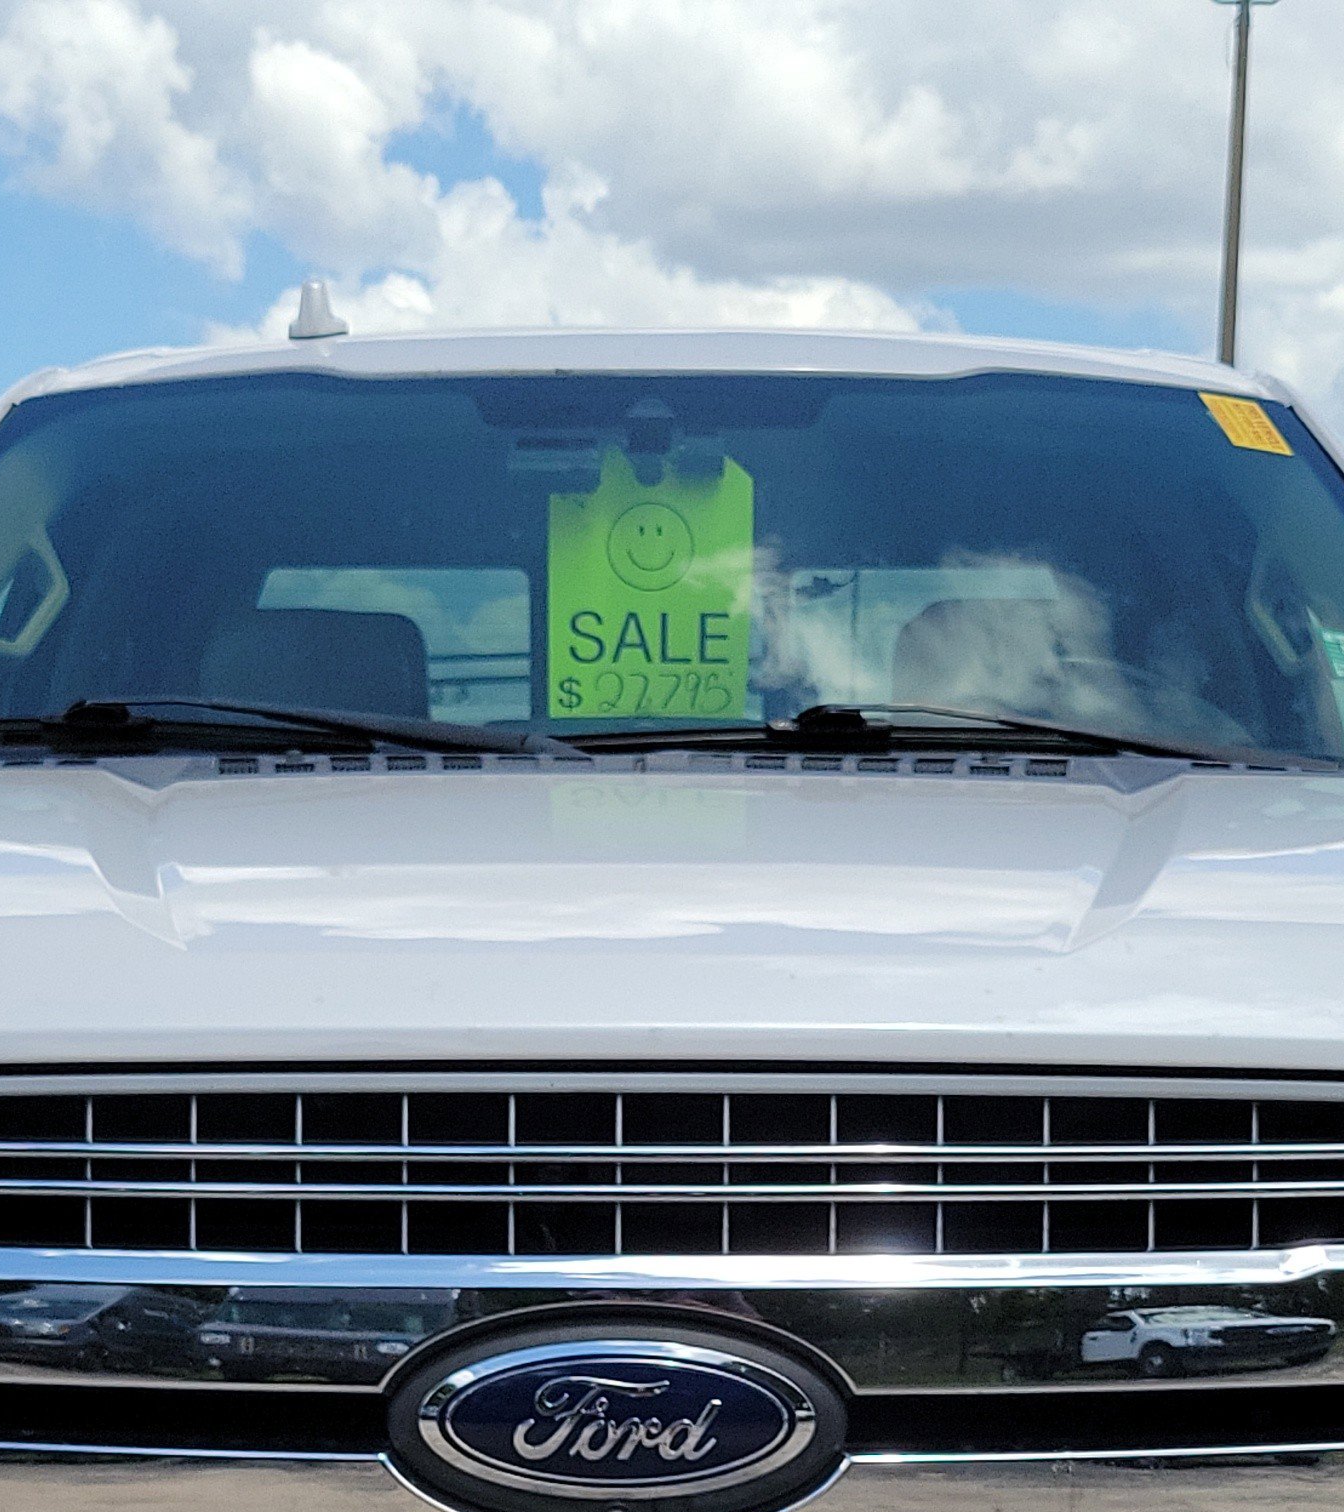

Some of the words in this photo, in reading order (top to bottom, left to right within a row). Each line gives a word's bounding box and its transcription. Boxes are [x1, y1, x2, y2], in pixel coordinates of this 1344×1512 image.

[569, 610, 730, 665] SALE
[558, 676, 583, 711] $
[512, 1374, 722, 1461] Ford
